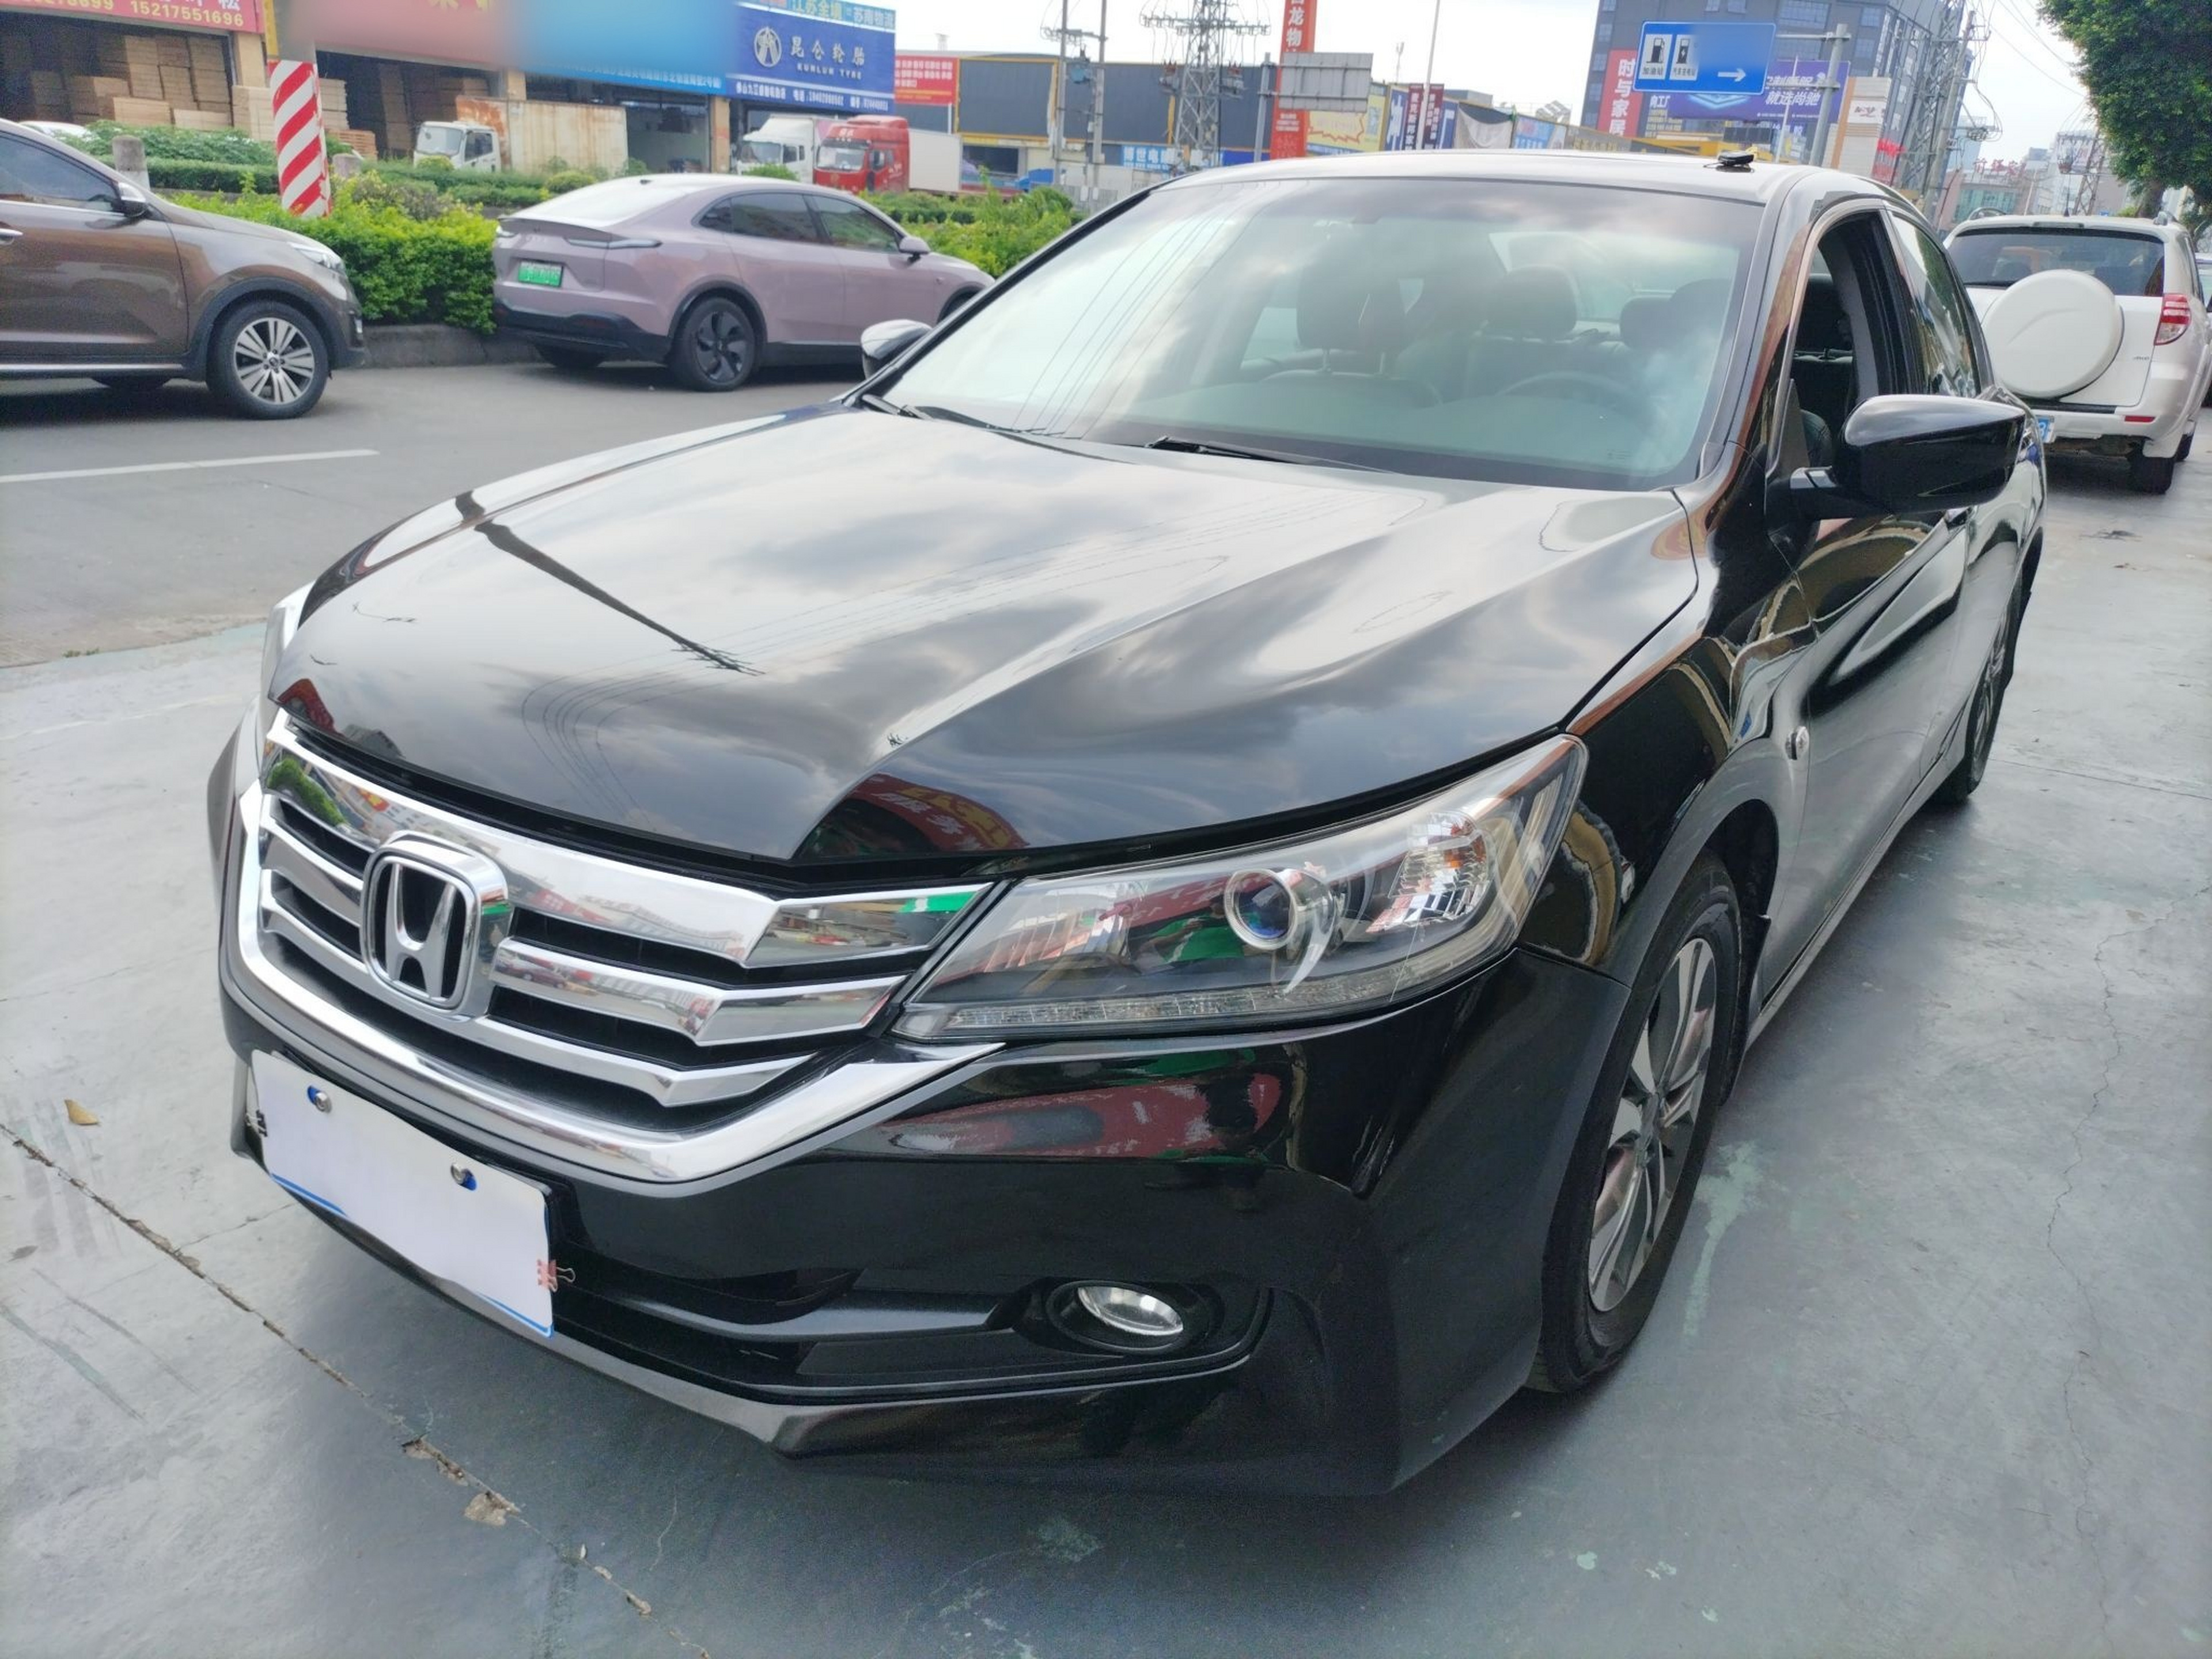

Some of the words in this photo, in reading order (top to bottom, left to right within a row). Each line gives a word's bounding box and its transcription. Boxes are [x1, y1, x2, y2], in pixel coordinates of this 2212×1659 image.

[131, 1, 244, 26] 15217551696
[1286, 0, 1305, 52] 龙物
[791, 36, 865, 66] 昆仑轮胎
[797, 63, 835, 75] KUNLUN
[839, 68, 862, 80] TYRE
[1642, 67, 1663, 76] 加油站
